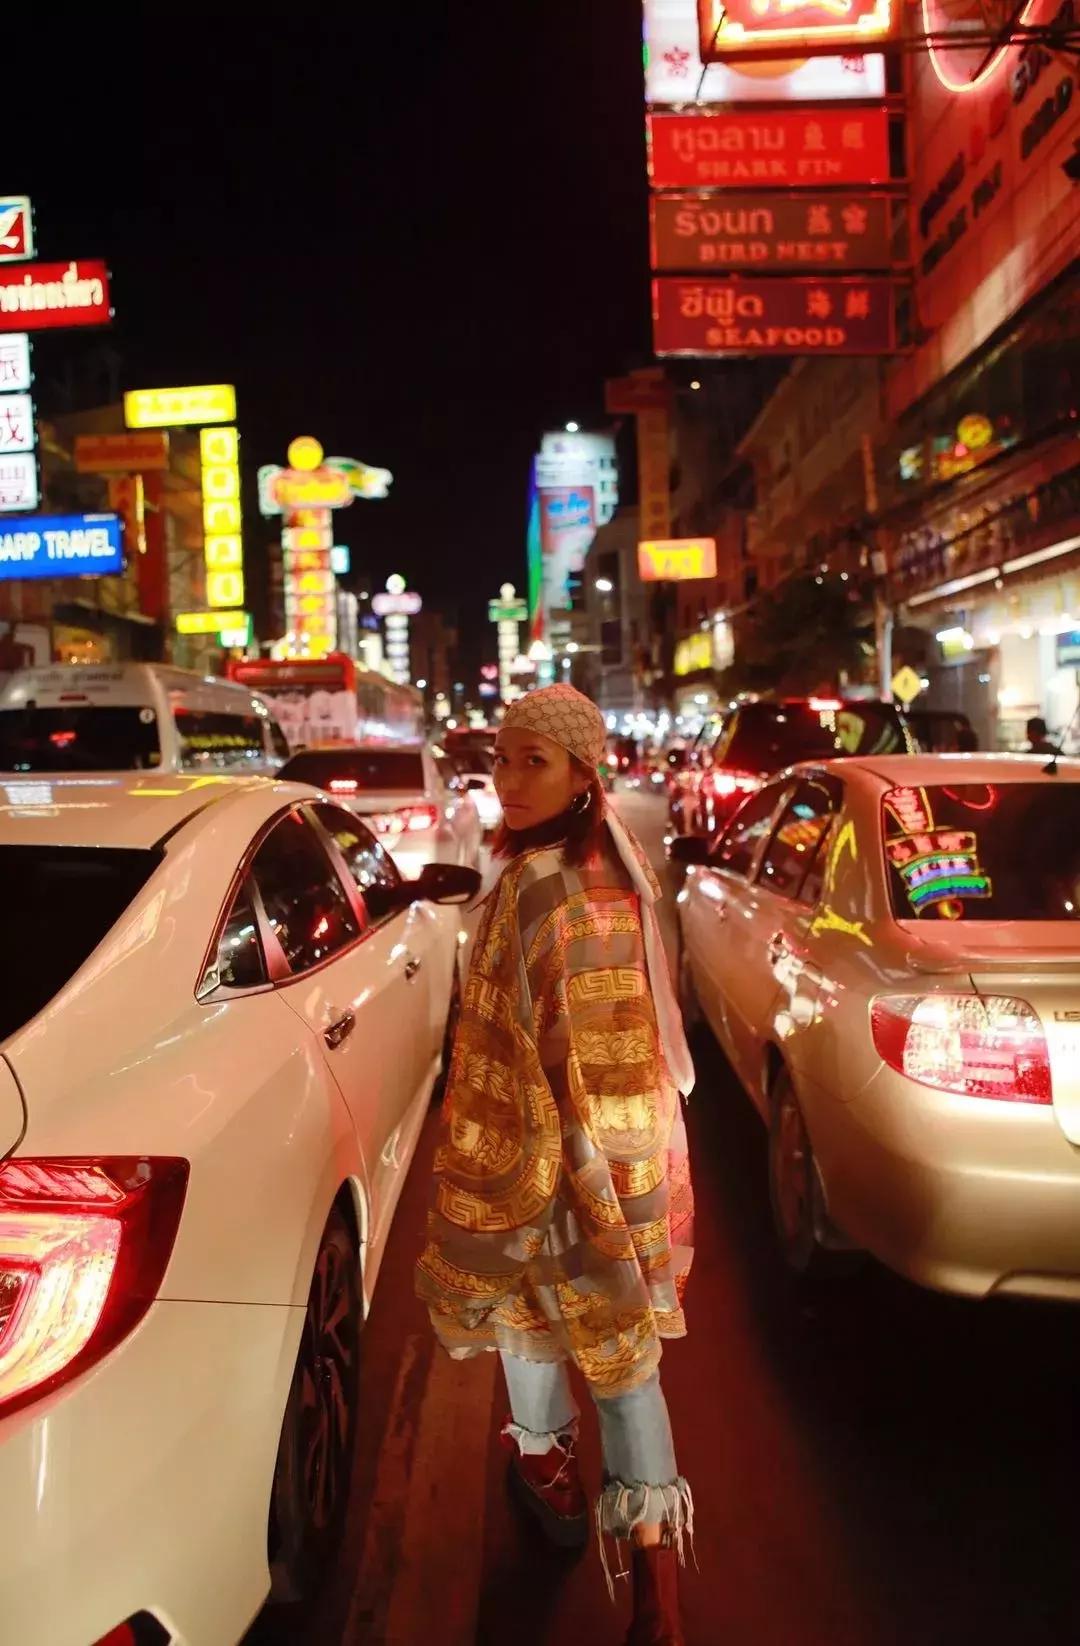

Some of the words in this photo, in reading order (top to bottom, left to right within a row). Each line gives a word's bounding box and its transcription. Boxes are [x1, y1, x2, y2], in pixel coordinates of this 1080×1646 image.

[672, 126, 785, 163] หูฉลาม
[698, 159, 786, 178] SHARK
[798, 159, 842, 175] FIN
[674, 202, 775, 236] รังนก
[700, 242, 768, 262] BIRD
[776, 241, 849, 261] NEST
[705, 326, 846, 347] SEAFOOD
[0, 531, 41, 562] ARP
[43, 528, 116, 560] TRAVEL
